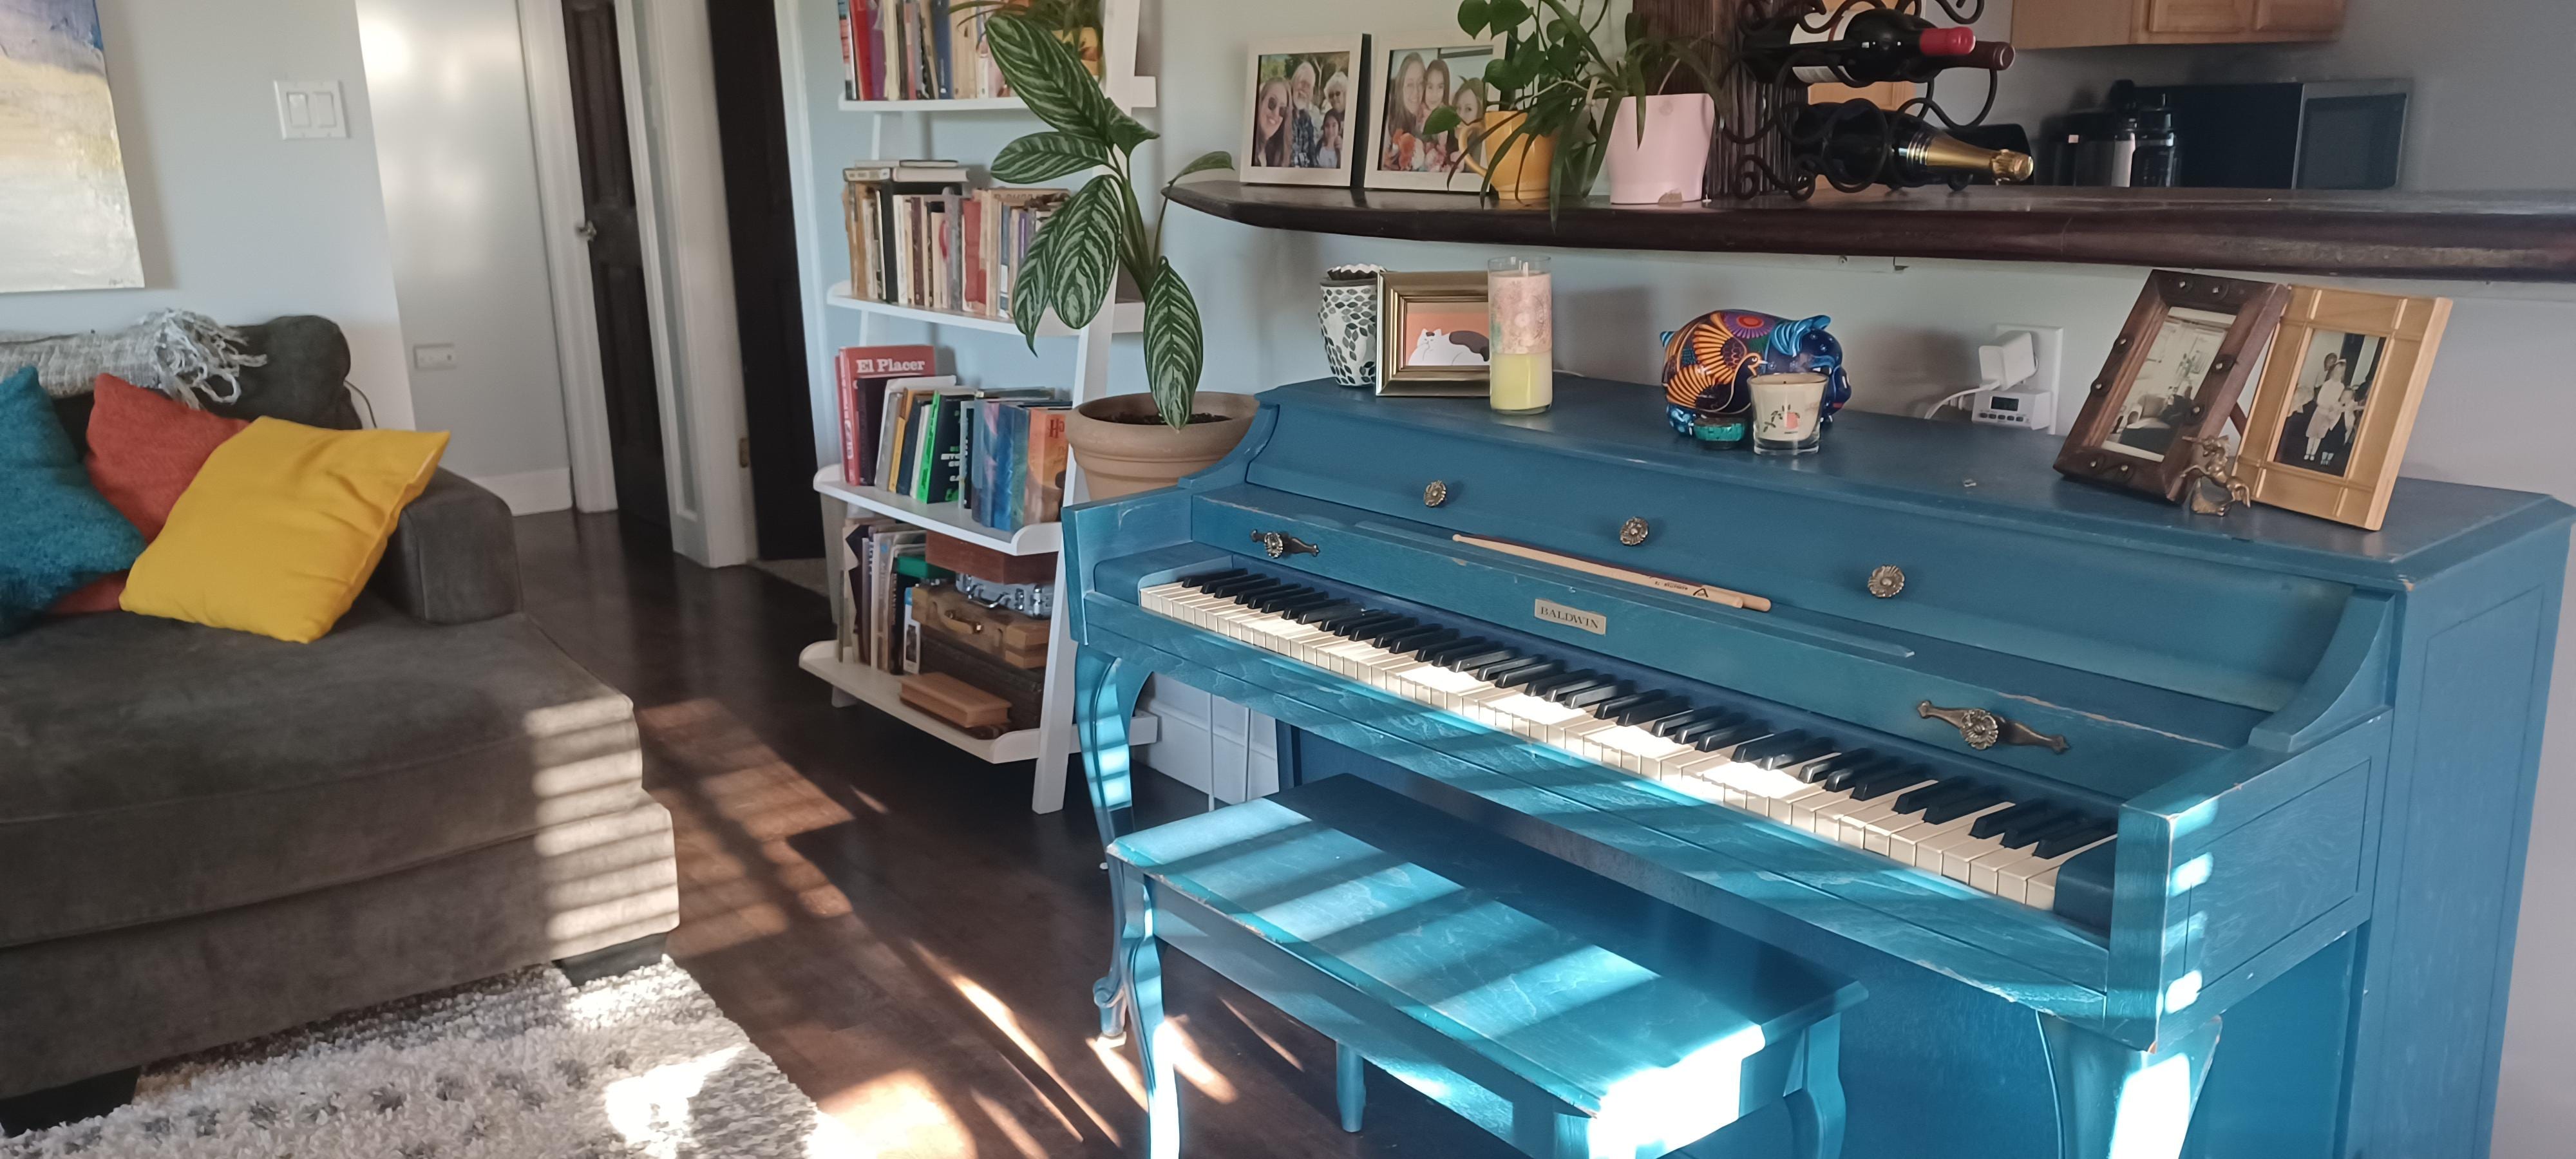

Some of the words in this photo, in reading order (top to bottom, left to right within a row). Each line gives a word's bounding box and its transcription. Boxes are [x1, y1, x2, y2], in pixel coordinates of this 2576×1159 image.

[856, 359, 875, 373] El
[876, 358, 925, 372] Placer
[1540, 607, 1599, 629] BALDWIN
